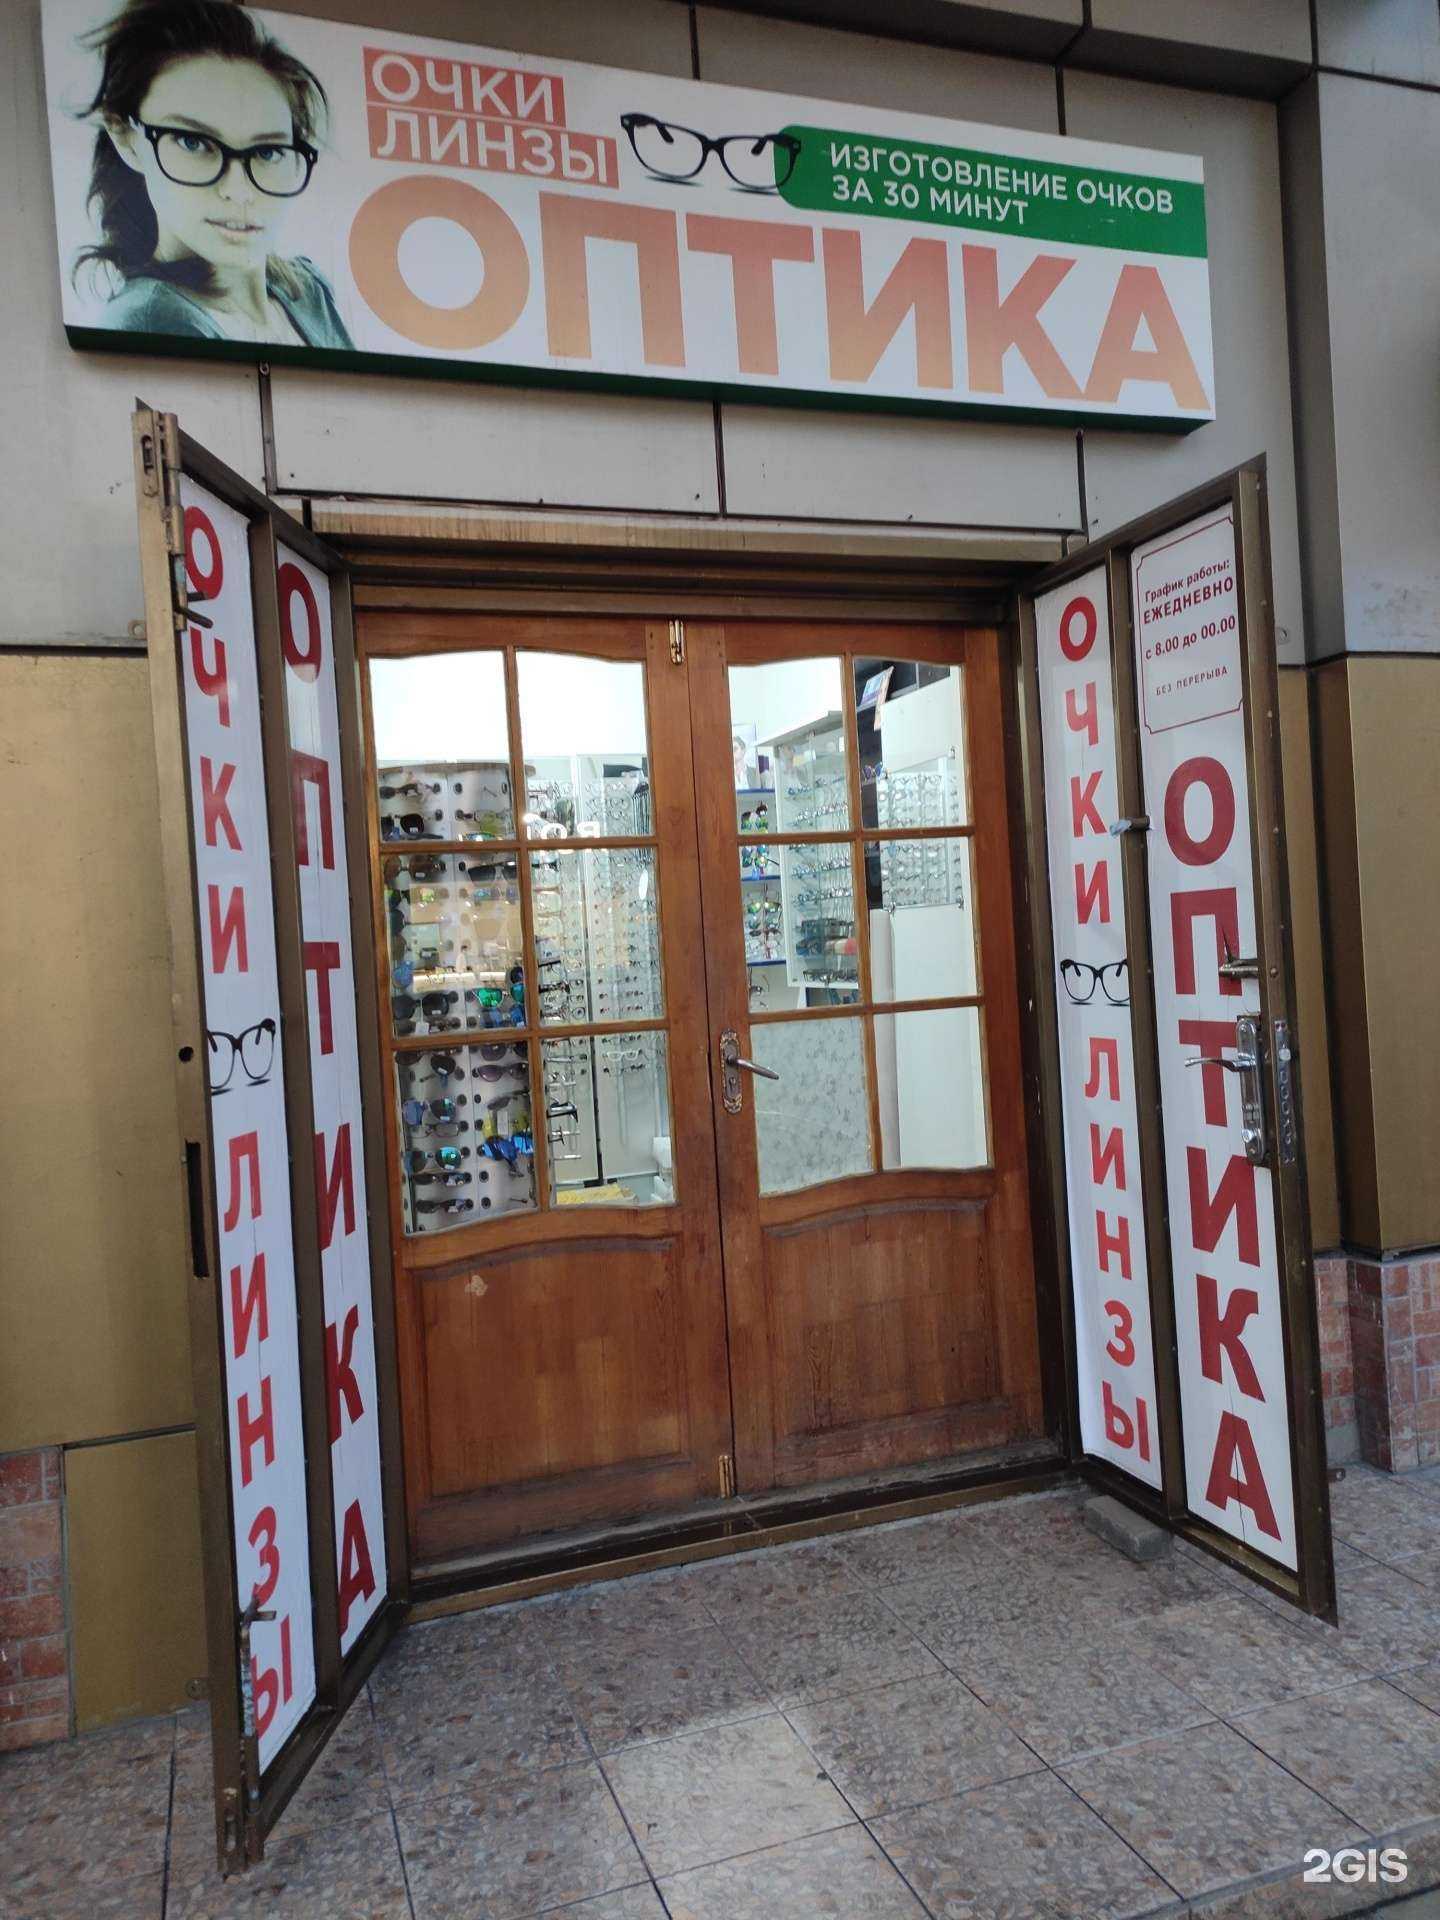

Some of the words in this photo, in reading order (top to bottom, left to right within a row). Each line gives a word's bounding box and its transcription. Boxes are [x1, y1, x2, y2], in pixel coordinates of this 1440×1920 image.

[372, 54, 554, 123] ОЧКИ
[377, 109, 608, 184] ЛИНЗЫ
[829, 142, 1068, 201] ИЗГОТОВЛЕНИЕ
[1076, 179, 1175, 214] ОЧКОВ
[833, 176, 874, 204] ЗА
[883, 180, 920, 209] 30
[929, 187, 1029, 226] МИНУТ
[348, 174, 1212, 410] ОПТИКА
[1143, 576, 1234, 624] ЕЖЕДНЕВНО
[1144, 580, 1184, 603] График
[1186, 559, 1230, 588] работы:
[1145, 648, 1152, 660] с
[1154, 636, 1180, 657] 8.00
[1182, 632, 1197, 651] до
[1200, 615, 1236, 640] 00.00
[1155, 682, 1173, 696] БЕЗ
[1176, 665, 1229, 690] ПЕРЕРЫВА
[183, 505, 249, 974] ОЧКИ
[1059, 596, 1111, 925] ОЧКИ
[277, 562, 376, 1638] ОПТИКА
[1163, 756, 1281, 1542] ОПТИКА
[1084, 1036, 1151, 1462] ЛИНЗЫ
[223, 1129, 294, 1739] ЛИНЗЫ
